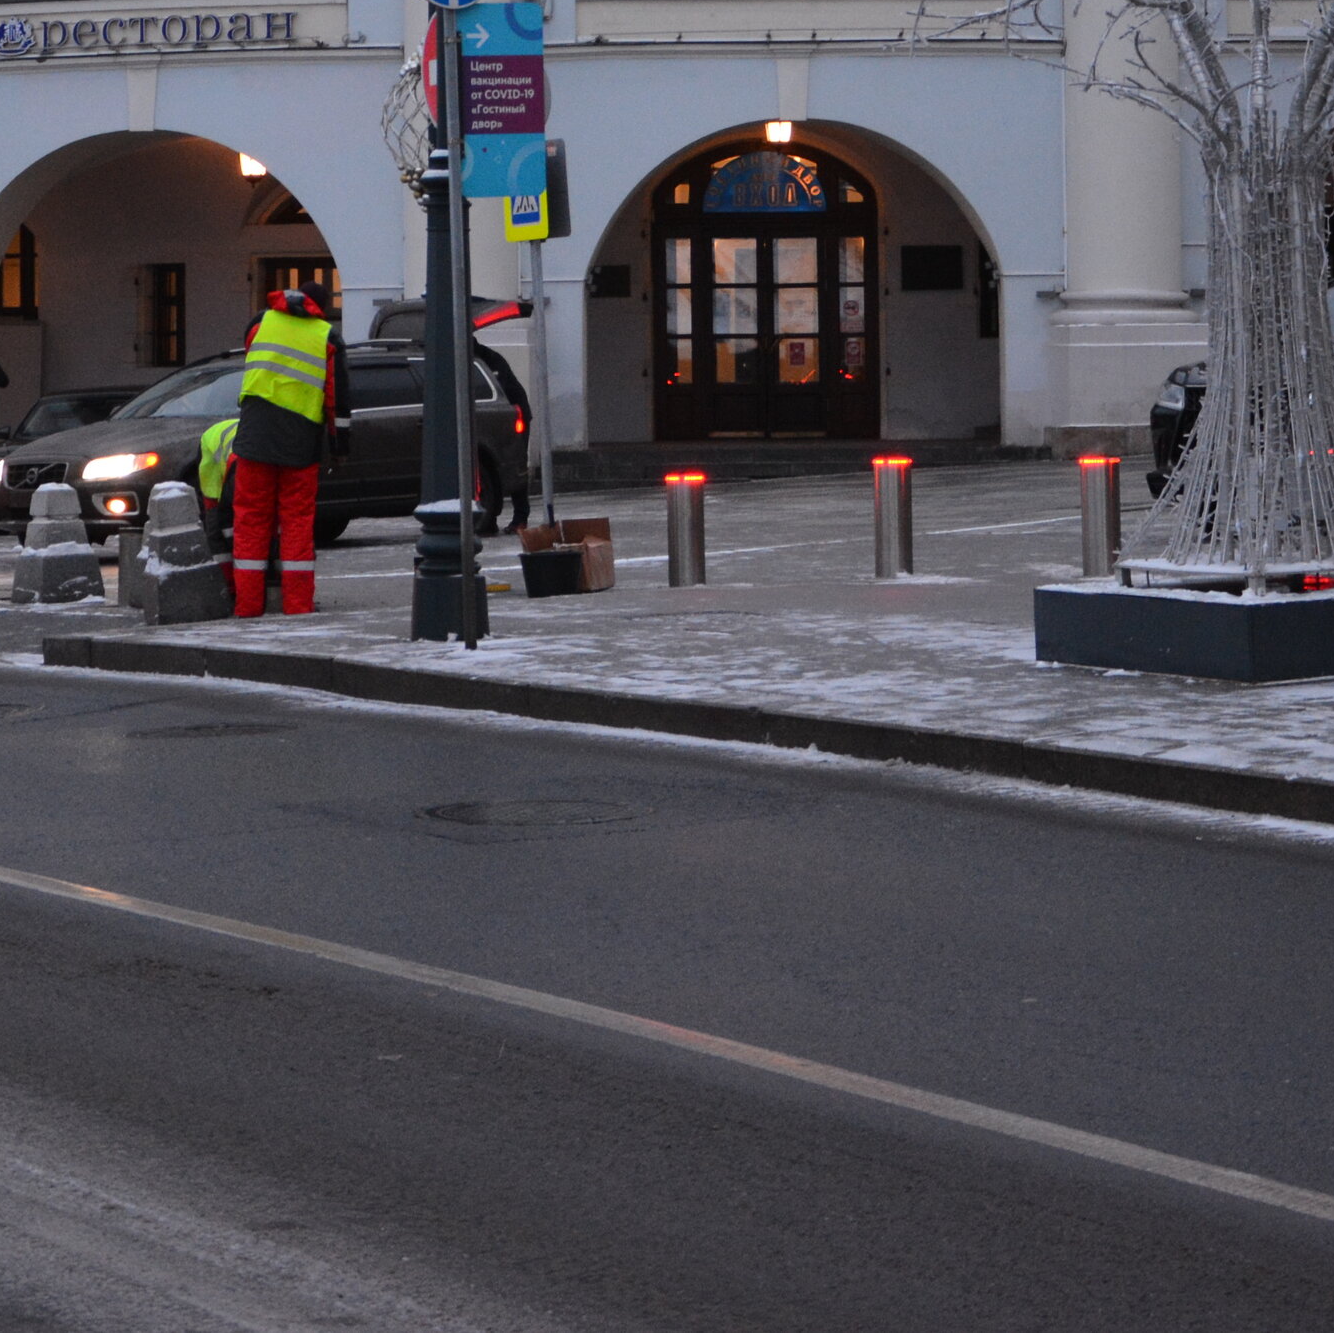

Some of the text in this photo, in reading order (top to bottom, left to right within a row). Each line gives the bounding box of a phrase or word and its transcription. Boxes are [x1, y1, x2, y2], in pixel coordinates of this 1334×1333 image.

[41, 11, 298, 54] ресторан
[470, 60, 503, 73] Центр
[470, 76, 532, 86] вакцинации
[470, 88, 535, 100] от COVID-19
[471, 103, 525, 114] «Гостиный
[471, 120, 503, 130] двор»
[734, 183, 798, 207] ВХОД
